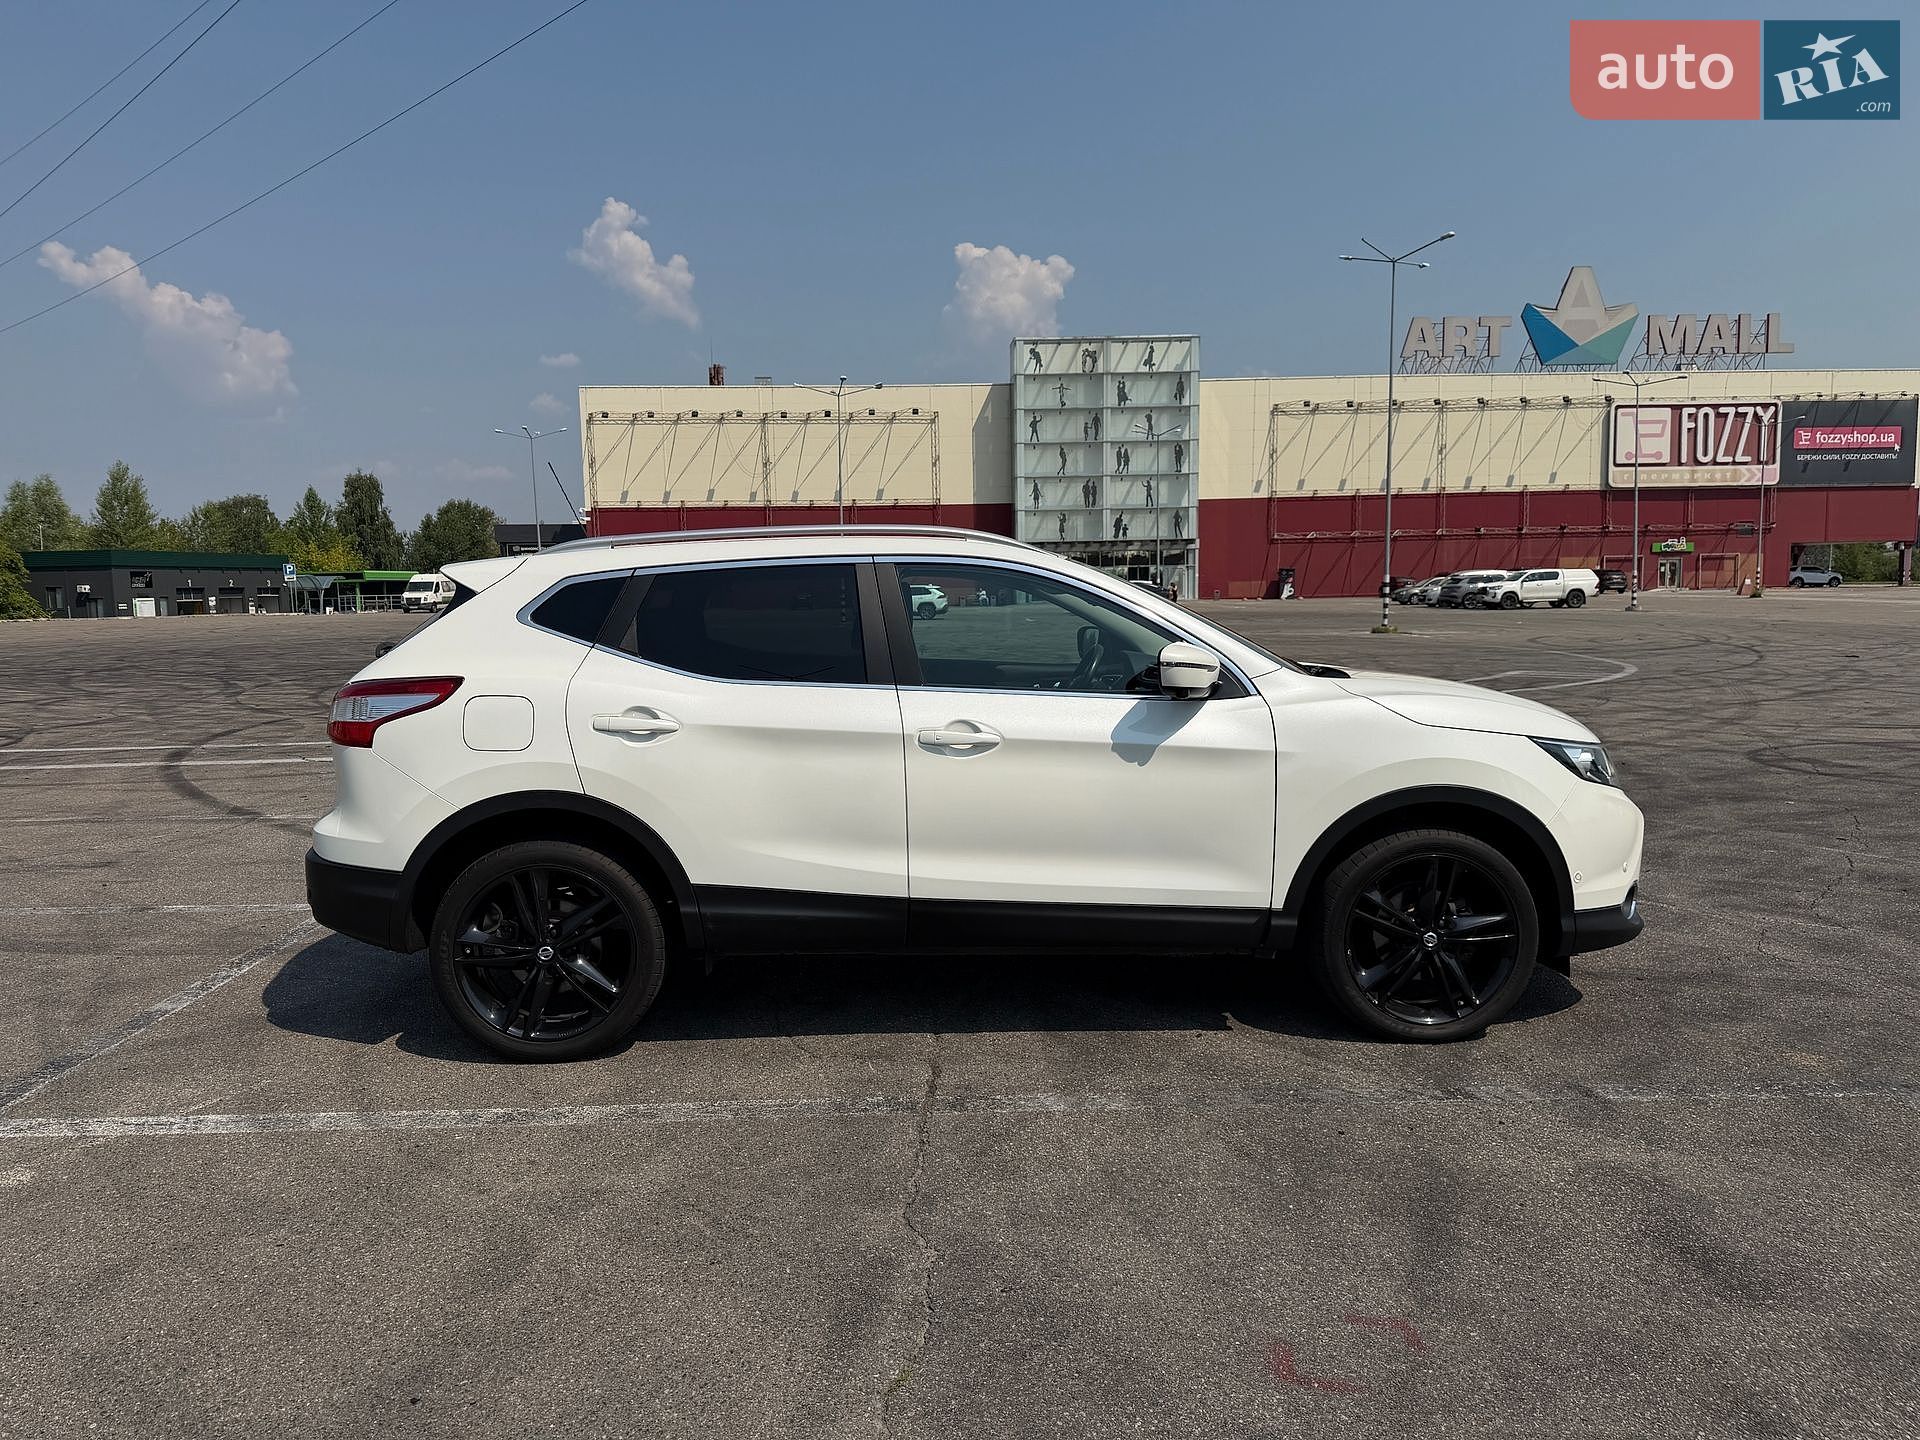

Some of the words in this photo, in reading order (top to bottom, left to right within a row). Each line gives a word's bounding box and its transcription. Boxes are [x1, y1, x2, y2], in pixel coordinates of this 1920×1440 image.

[1399, 316, 1512, 358] ART
[1647, 313, 1796, 355] MALL
[1680, 406, 1776, 463] FOZZY
[1815, 430, 1895, 445] fozzyshop.ua
[1623, 471, 1732, 481] гпермаркет
[287, 566, 293, 574] P
[187, 579, 192, 587] 1
[229, 579, 234, 587] 2
[266, 579, 271, 587] 3
